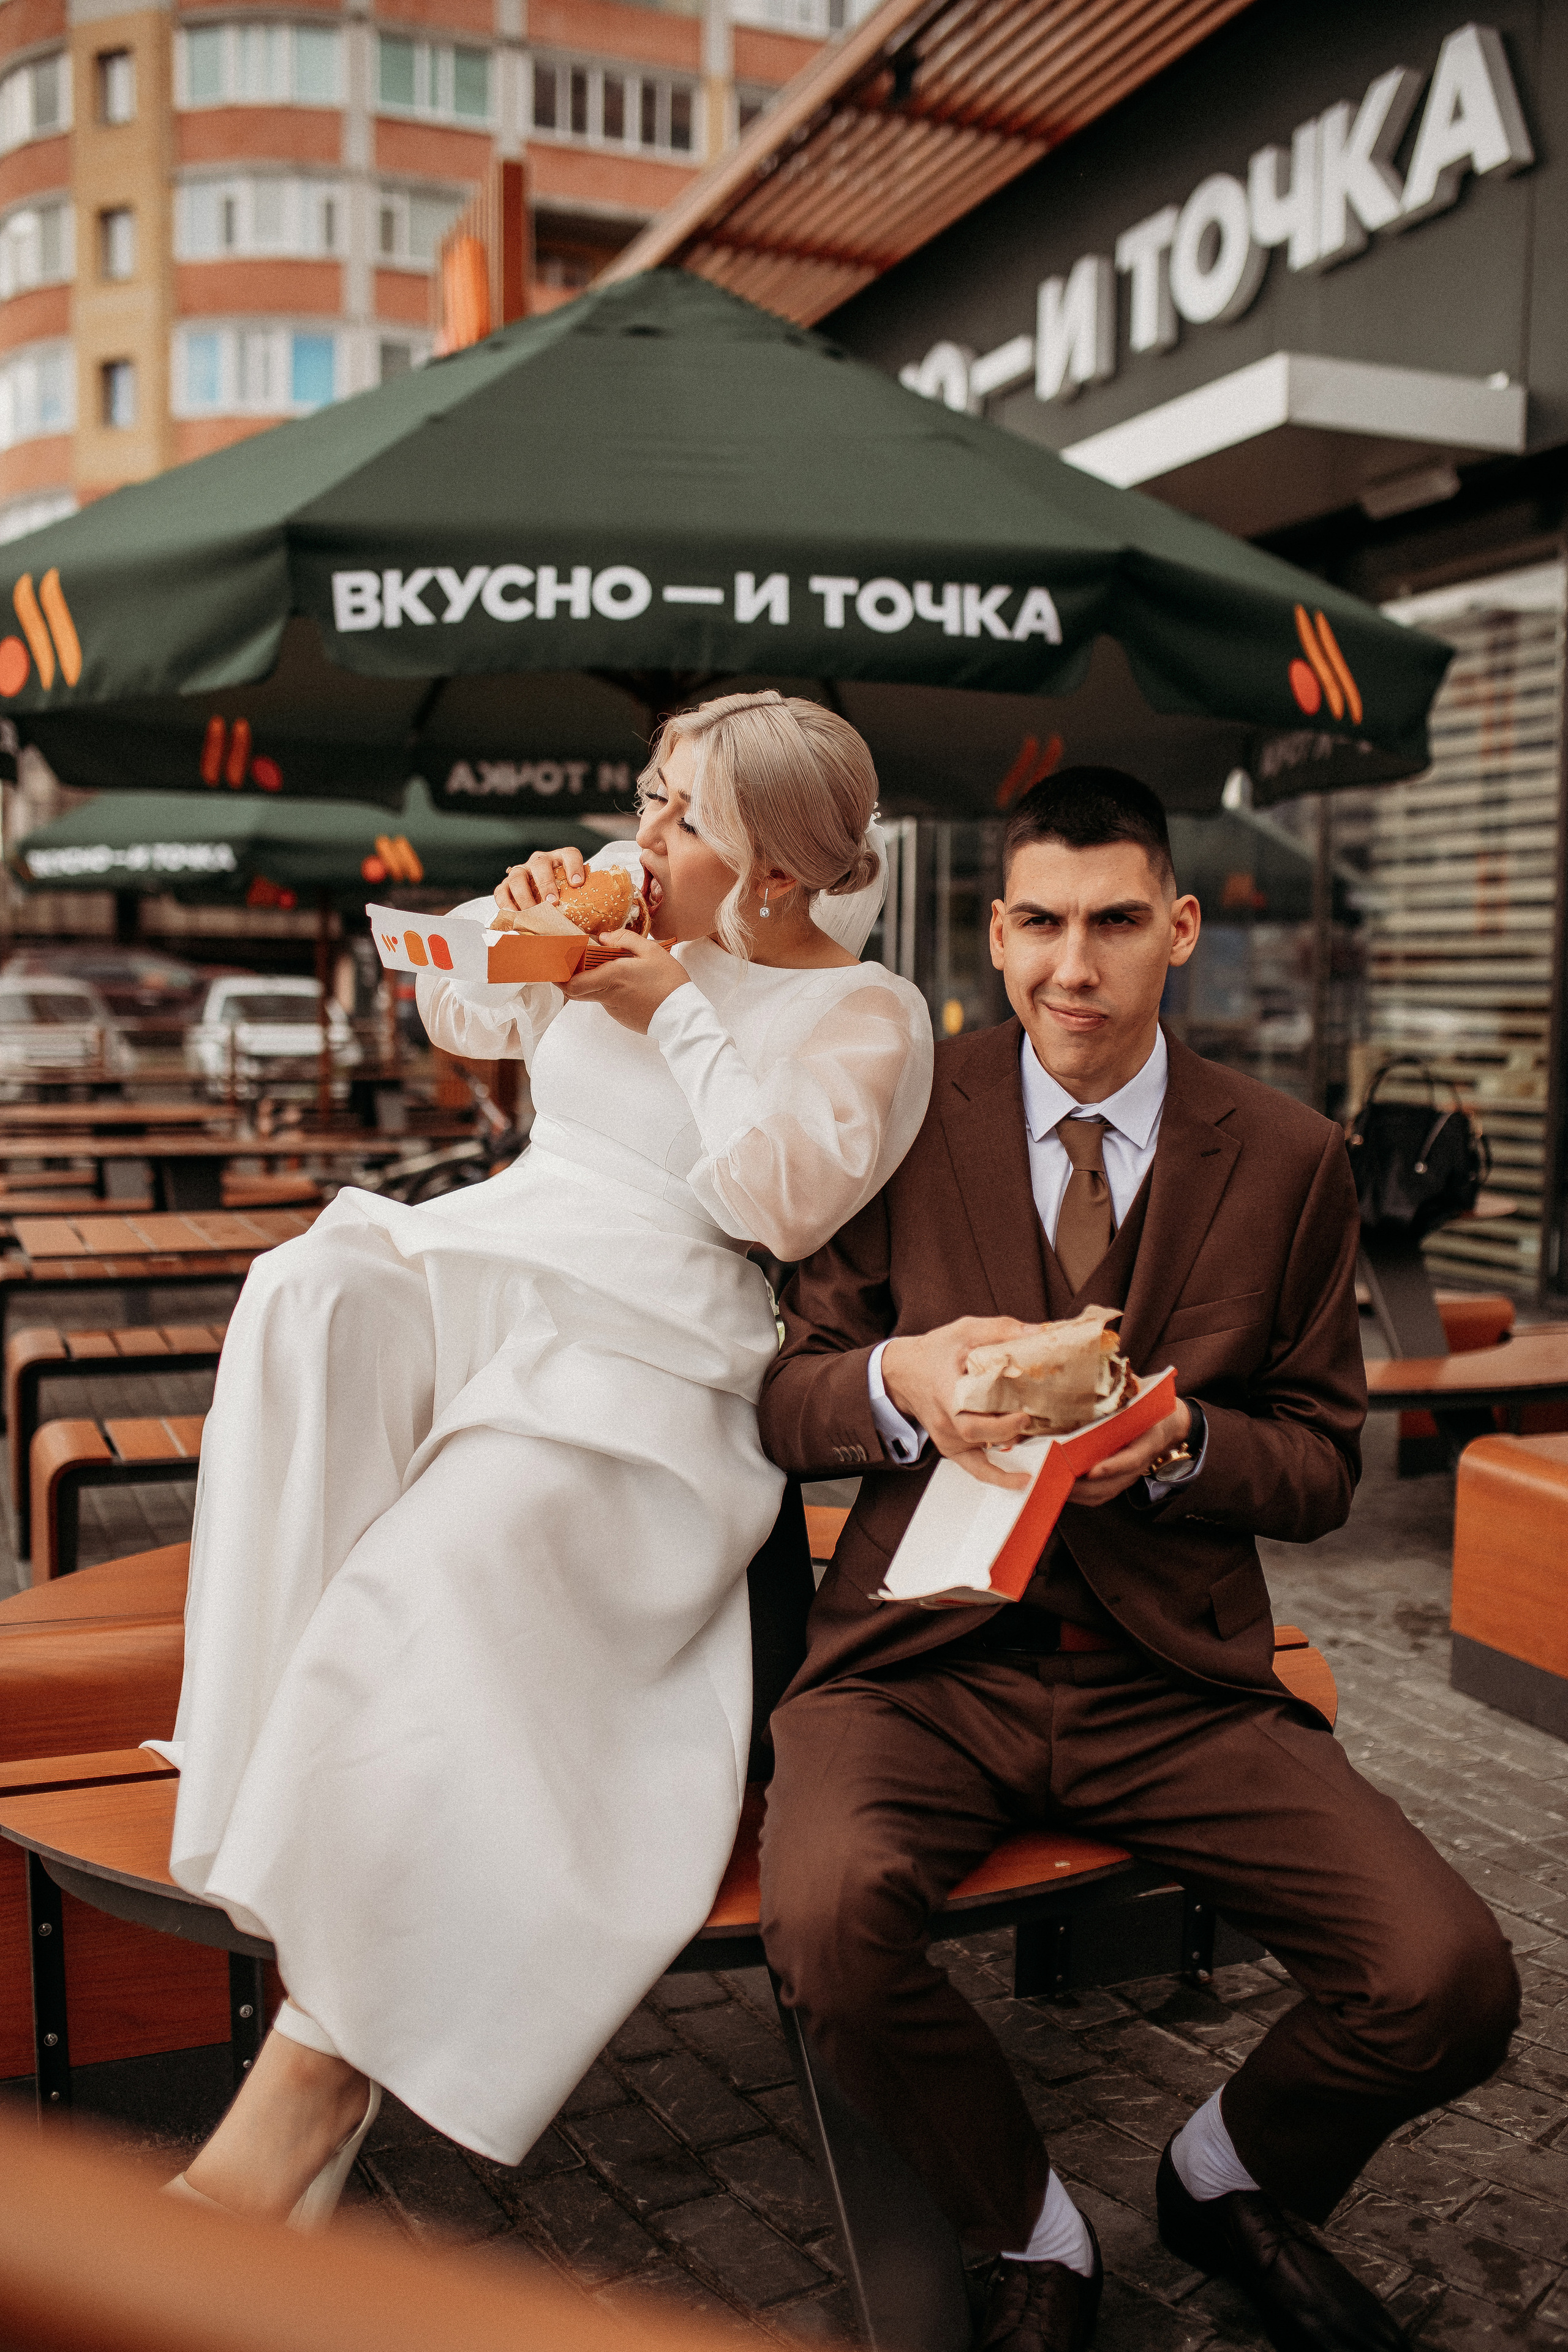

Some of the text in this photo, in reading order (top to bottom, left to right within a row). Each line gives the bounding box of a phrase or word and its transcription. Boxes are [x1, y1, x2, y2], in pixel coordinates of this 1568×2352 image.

[1035, 253, 1107, 402] И
[1115, 22, 1525, 354] ТОЧКА
[331, 564, 653, 633] ВКУСНО
[734, 570, 790, 626] И
[808, 574, 1063, 646] ТОЧКА
